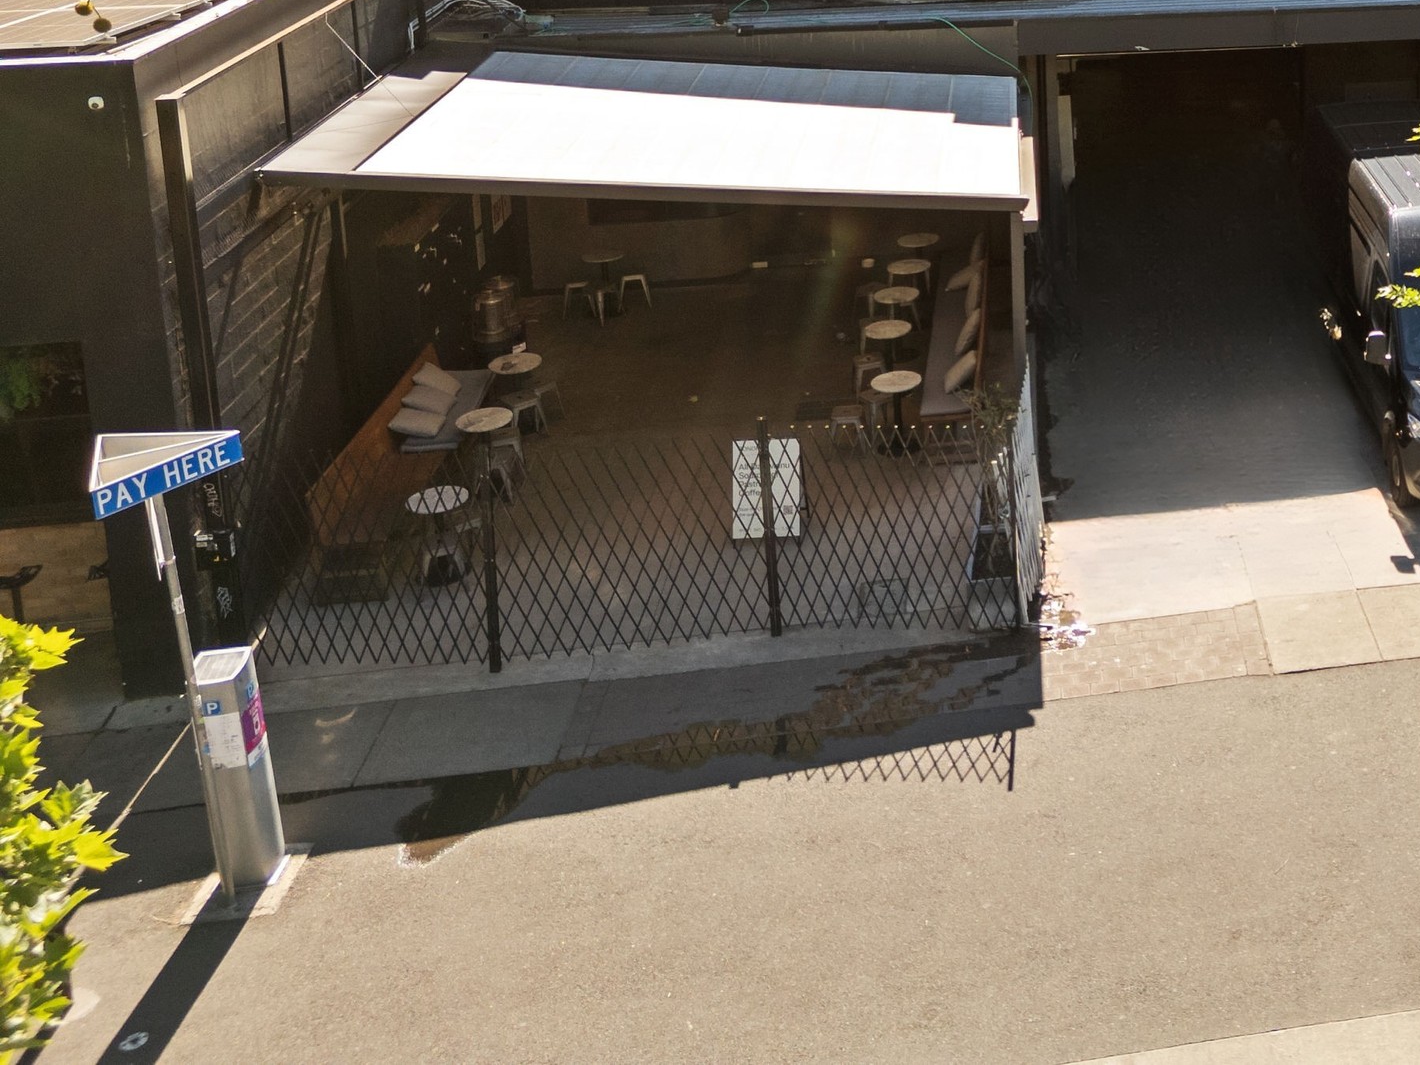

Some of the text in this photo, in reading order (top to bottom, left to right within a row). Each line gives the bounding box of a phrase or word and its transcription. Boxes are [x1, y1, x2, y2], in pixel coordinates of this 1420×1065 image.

[96, 472, 148, 515] PAY
[162, 440, 231, 489] HERE
[206, 702, 218, 715] P
